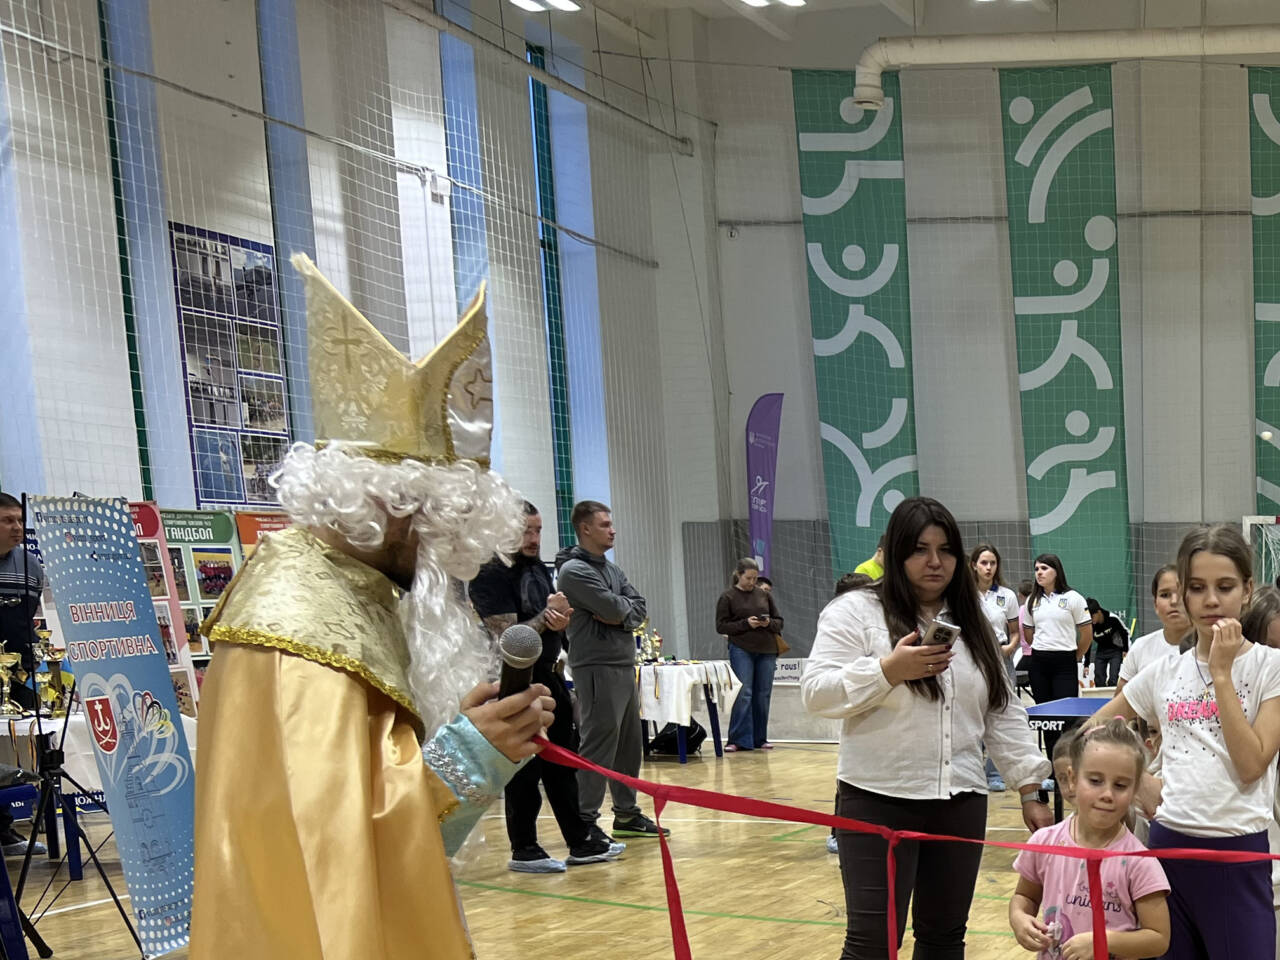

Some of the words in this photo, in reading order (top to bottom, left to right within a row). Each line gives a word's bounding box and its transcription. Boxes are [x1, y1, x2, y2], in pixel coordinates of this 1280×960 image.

[165, 526, 214, 542] ГАНДБОЛ
[69, 601, 136, 624] ВІННИЦЯ
[68, 634, 159, 662] СПОРТИВНА
[1029, 720, 1066, 731] SPORT
